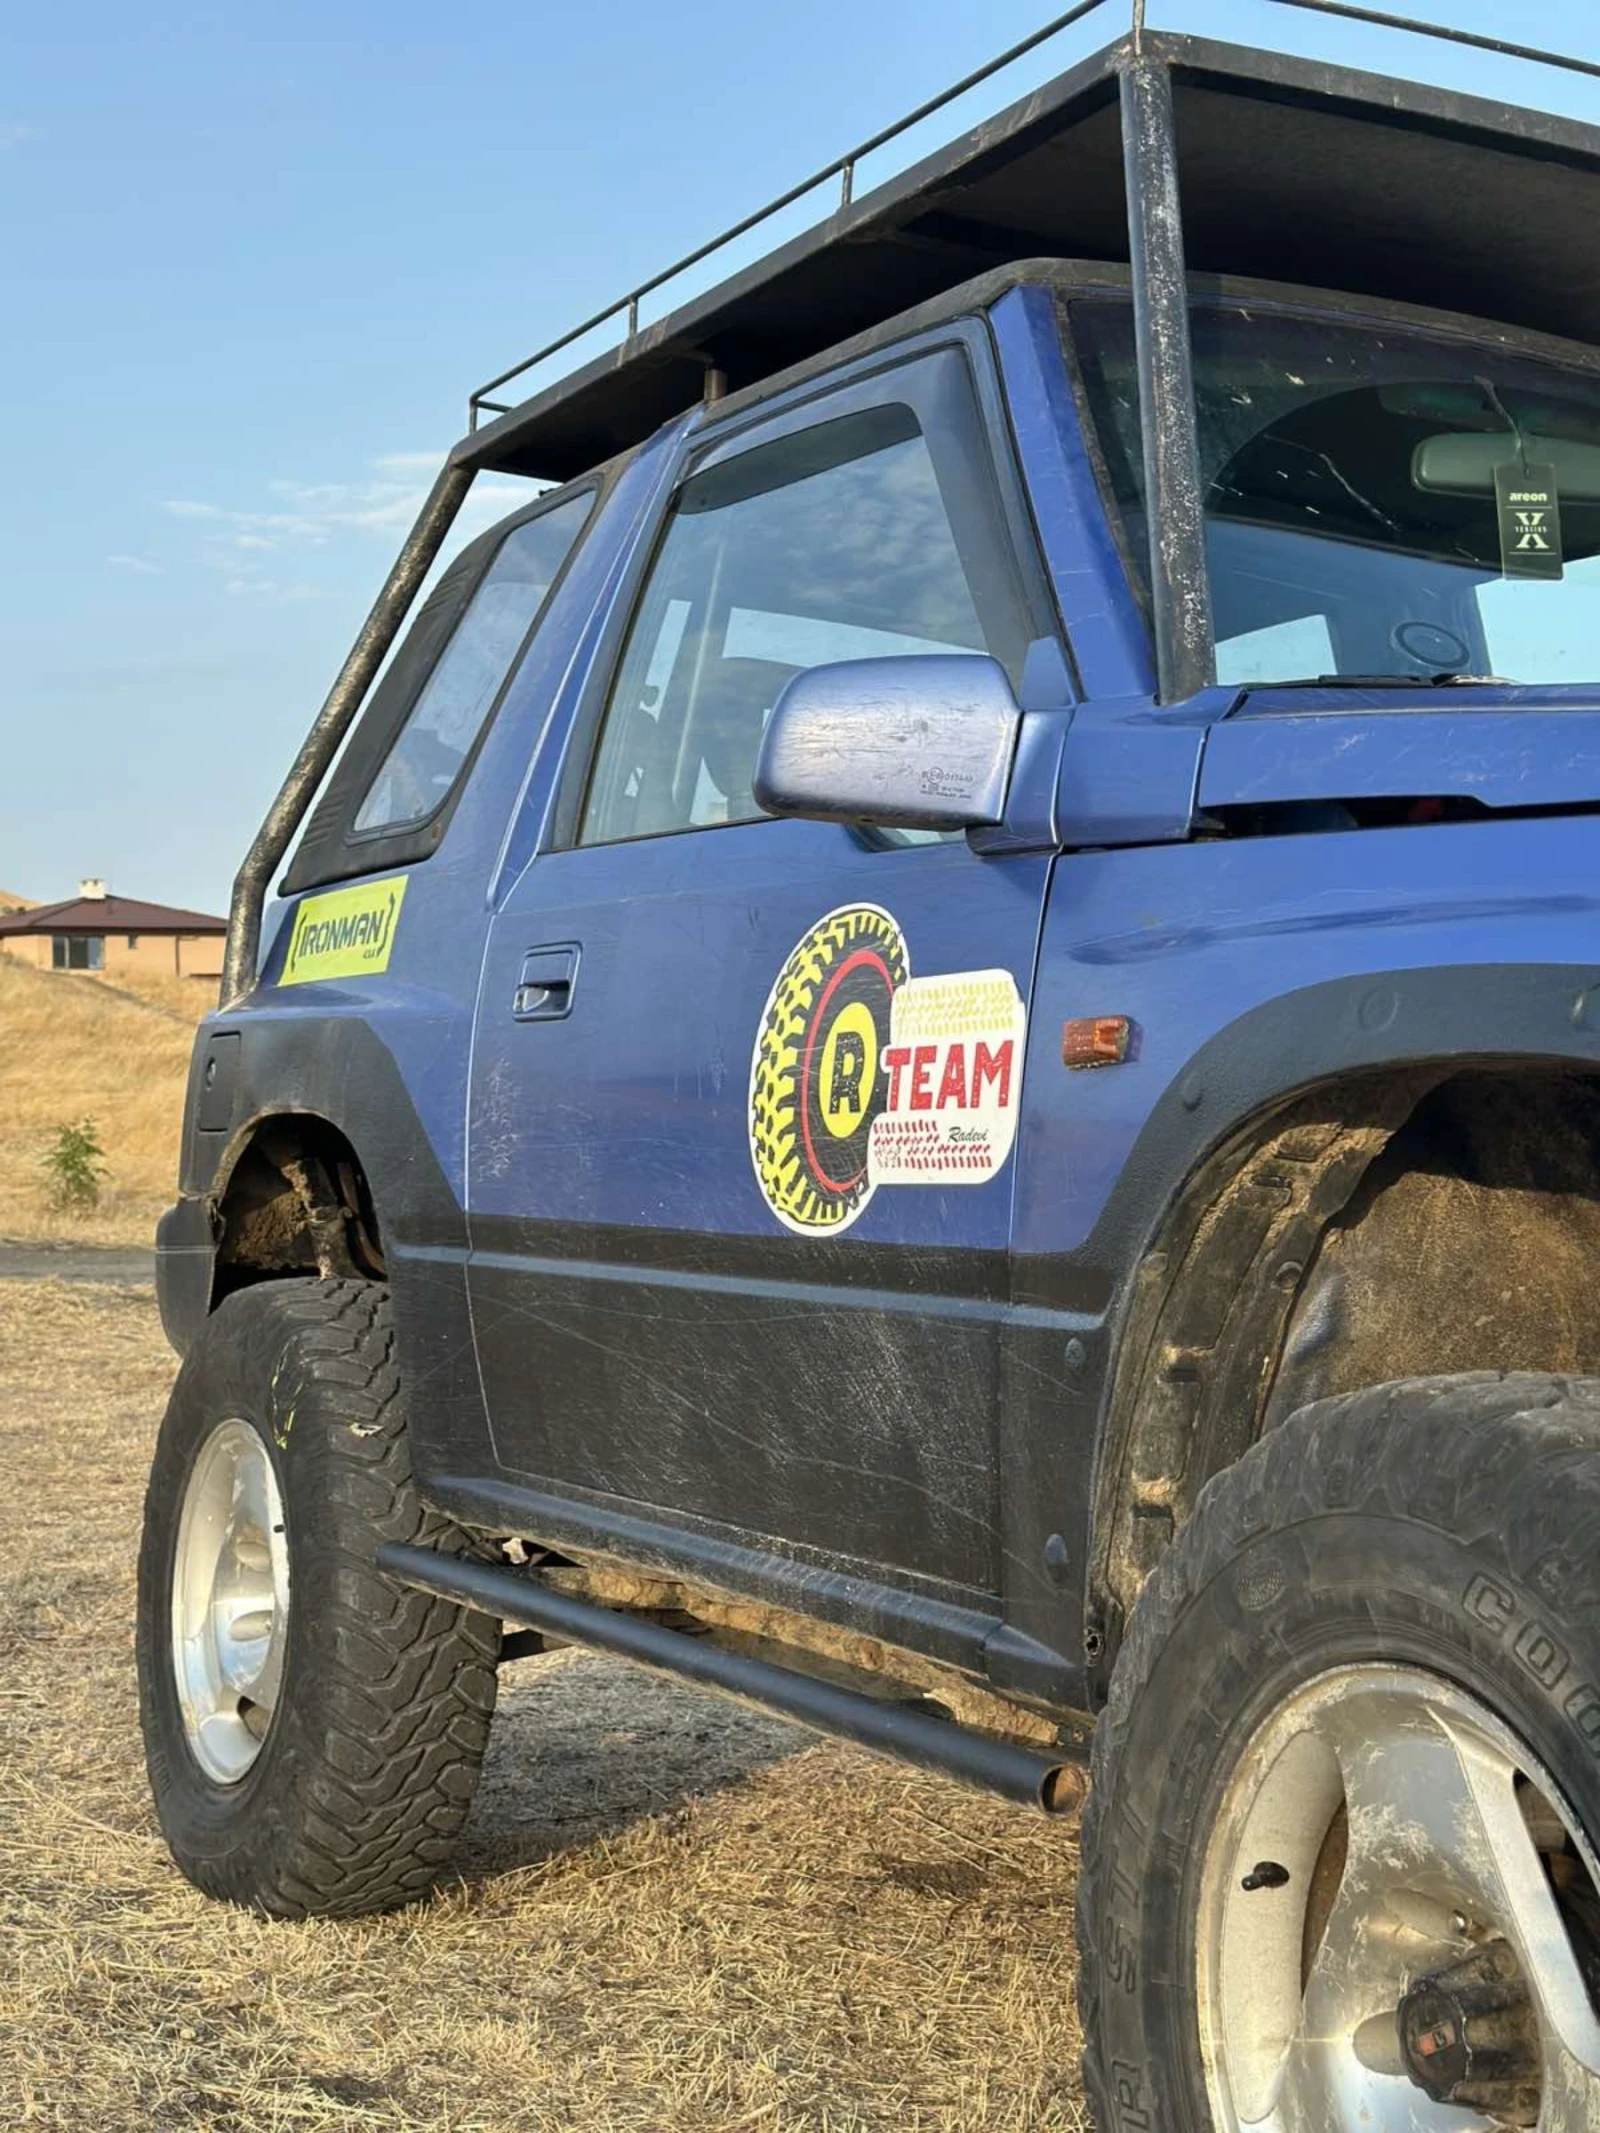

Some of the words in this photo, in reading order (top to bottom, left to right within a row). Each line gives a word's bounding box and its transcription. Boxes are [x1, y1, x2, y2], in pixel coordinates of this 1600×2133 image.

[1509, 492, 1547, 502] areon
[298, 909, 385, 958] IRONMAN
[829, 1031, 865, 1114] R
[885, 1040, 1014, 1112] TEAM
